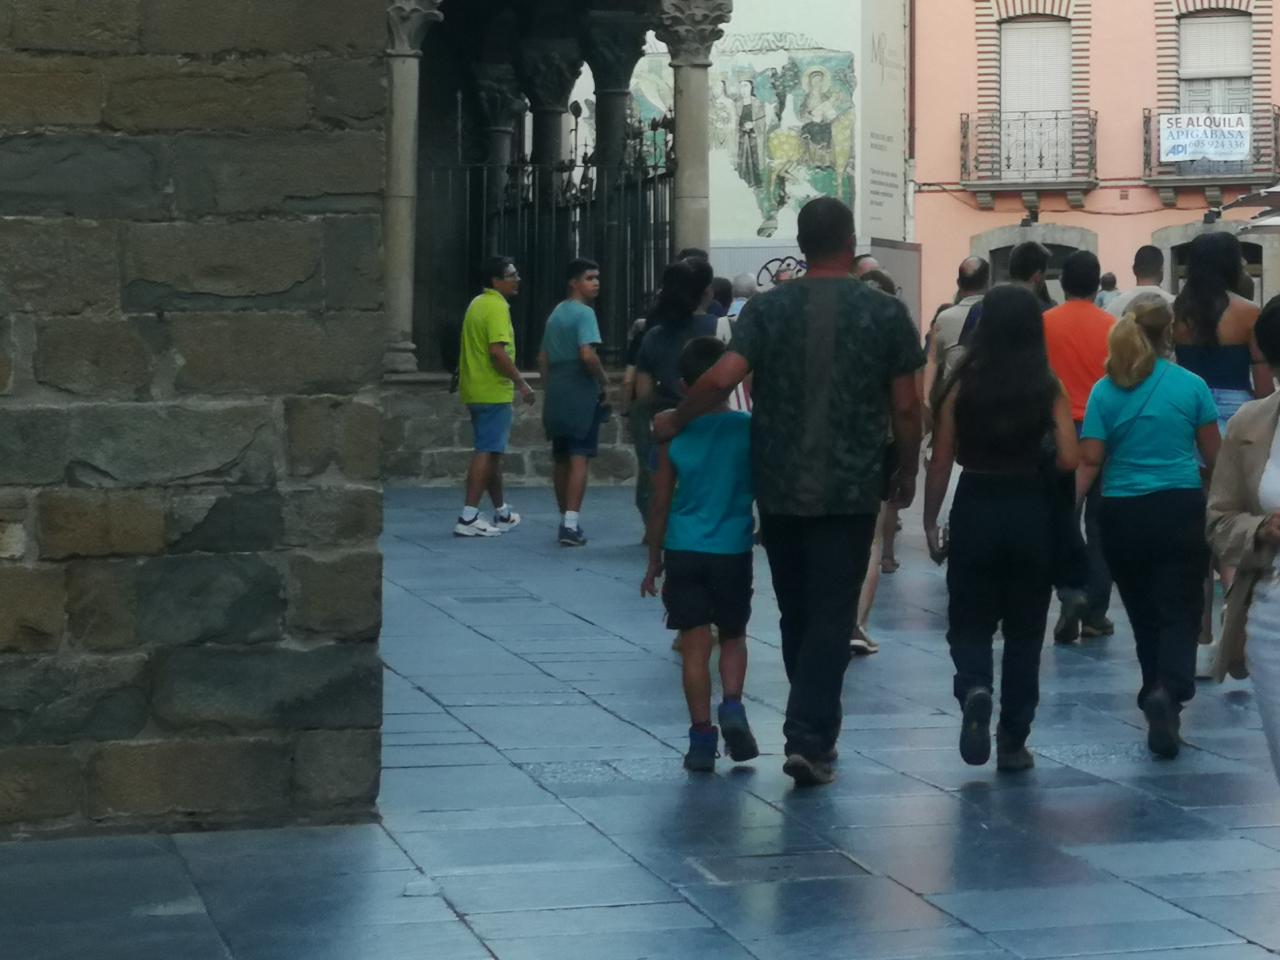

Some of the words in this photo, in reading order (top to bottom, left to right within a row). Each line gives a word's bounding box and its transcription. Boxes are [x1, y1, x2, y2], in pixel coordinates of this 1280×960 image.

[1167, 117, 1183, 129] SE
[1187, 116, 1245, 129] ALQUILA
[1167, 129, 1245, 141] APIGABASA
[1189, 140, 1206, 148] 605
[1208, 140, 1225, 149] 924
[1228, 140, 1246, 149] 336
